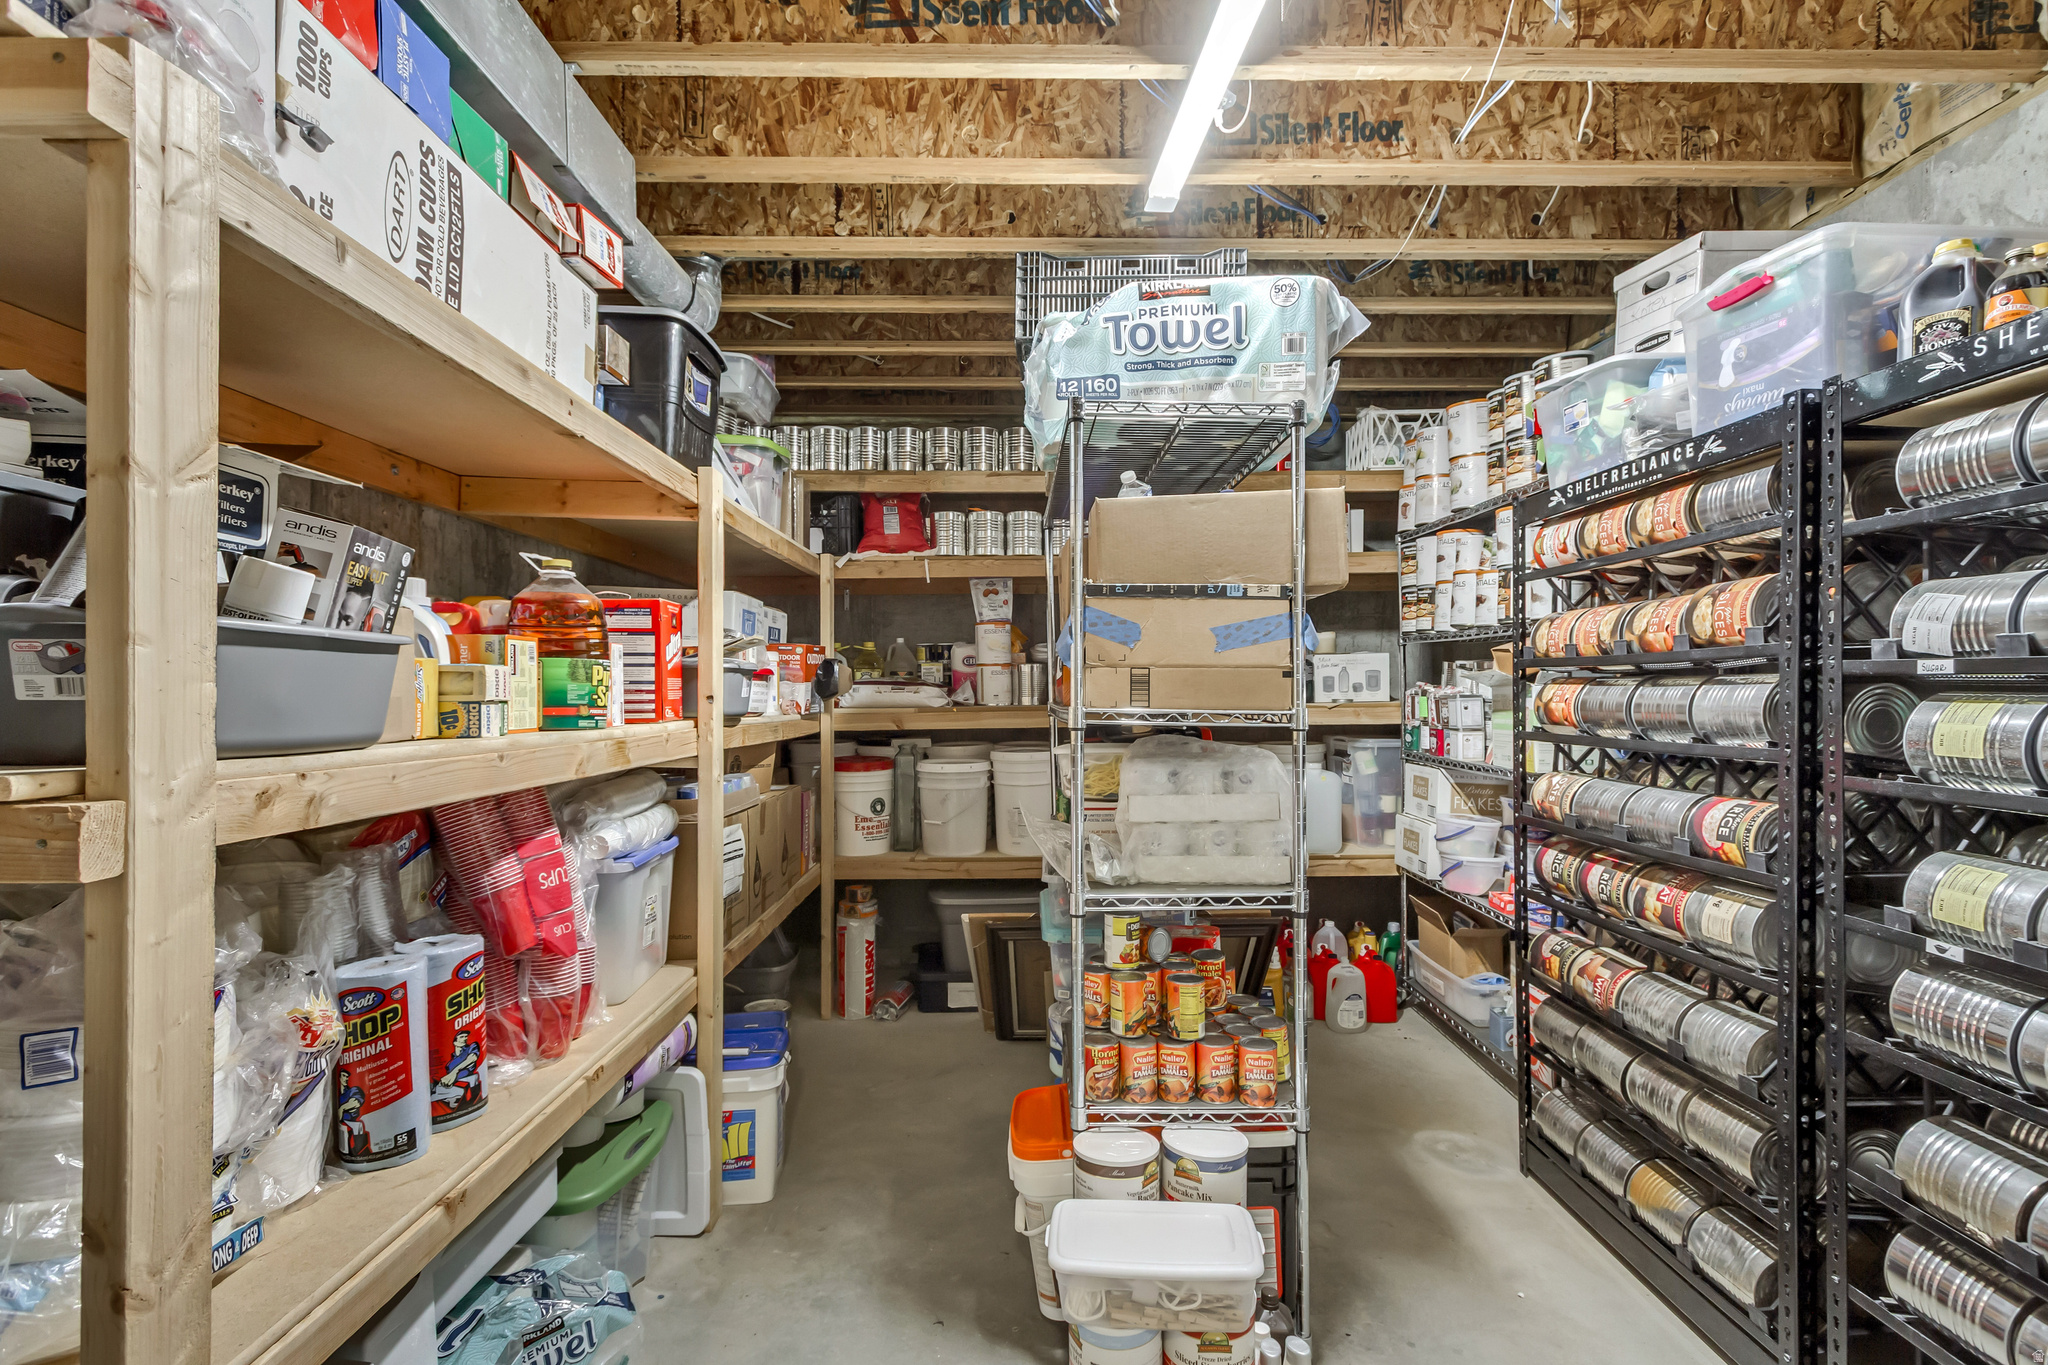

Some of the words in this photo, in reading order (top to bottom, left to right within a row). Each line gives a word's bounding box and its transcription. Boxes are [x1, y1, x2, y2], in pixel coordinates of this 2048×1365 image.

[295, 20, 319, 94] 1000
[317, 48, 333, 100] CUPS
[1259, 112, 1333, 146] Silent
[1338, 110, 1404, 143] Floor
[419, 139, 437, 225] CUPS
[438, 154, 448, 224] BEVERAGES
[390, 162, 406, 252] DART
[437, 224, 445, 257] COLD
[436, 257, 443, 276] OR
[449, 262, 461, 289] LID
[1453, 262, 1507, 285] Silent
[1273, 282, 1298, 294] 50%
[1137, 303, 1216, 320] PREMIUM
[1919, 314, 1945, 327] WESTERN
[1102, 304, 1248, 351] Towel
[1919, 321, 1963, 339] CLOVER
[1658, 334, 1670, 343] BOX
[1918, 335, 1964, 354] HONEY
[1126, 362, 1155, 371] Strong,
[1156, 360, 1176, 369] Thick
[1177, 358, 1192, 367] and
[1193, 356, 1235, 366] Absorbent
[1059, 379, 1079, 392] 12
[1085, 377, 1118, 393] 160
[1742, 383, 1765, 397] maxi
[29, 454, 81, 472] erkey
[1566, 443, 1695, 499] SHELFRELIANCE
[218, 483, 255, 503] erkey
[1586, 472, 1663, 502] www.shelfreliance.com
[217, 514, 249, 528] rifiers
[1654, 491, 1671, 533] SLICES
[285, 519, 338, 540] andis
[353, 541, 386, 563] andis
[346, 560, 370, 580] EASY
[370, 568, 390, 585] CUT
[1713, 592, 1731, 638] SLICES
[484, 641, 493, 653] 250
[665, 630, 681, 662] ultra
[1921, 662, 1947, 672] SUGAR
[414, 662, 426, 703] Swiffer
[1413, 783, 1429, 797] FLAKES
[1463, 785, 1495, 796] Potato
[1548, 777, 1569, 803] OATS
[1454, 795, 1503, 812] FLAKES
[1718, 806, 1745, 837] RICE
[1403, 837, 1419, 851] FLAKES
[1551, 853, 1564, 879] RICE
[433, 876, 448, 897] LTRA
[1599, 873, 1610, 901] RICE
[864, 938, 875, 996] HUSKY
[343, 991, 377, 1014] Scott
[343, 1004, 402, 1050] HOP
[339, 1037, 393, 1066] ORIGINAL
[1161, 1054, 1186, 1065] Nalley
[356, 1056, 389, 1074] Multiusos
[368, 1065, 389, 1080] Absorbe
[389, 1060, 405, 1071] aceite
[1160, 1067, 1189, 1077] TAMALES
[1247, 1057, 1273, 1068] Nalley
[374, 1075, 387, 1086] grasa
[1244, 1071, 1275, 1082] TAMALES
[396, 1132, 408, 1145] 55
[722, 1158, 755, 1171] tainLifter
[1126, 1186, 1150, 1198] Vegetarian
[1167, 1180, 1194, 1200] Pancake
[1196, 1192, 1213, 1202] Mix
[1175, 1179, 1200, 1192] Buttermilk
[211, 1205, 233, 1220] EALS
[211, 1242, 233, 1272] ONG
[240, 1223, 259, 1252] DEEP
[523, 1316, 563, 1343] RKLAND
[1174, 1350, 1200, 1365] Sliced
[1216, 1355, 1233, 1363] Dried
